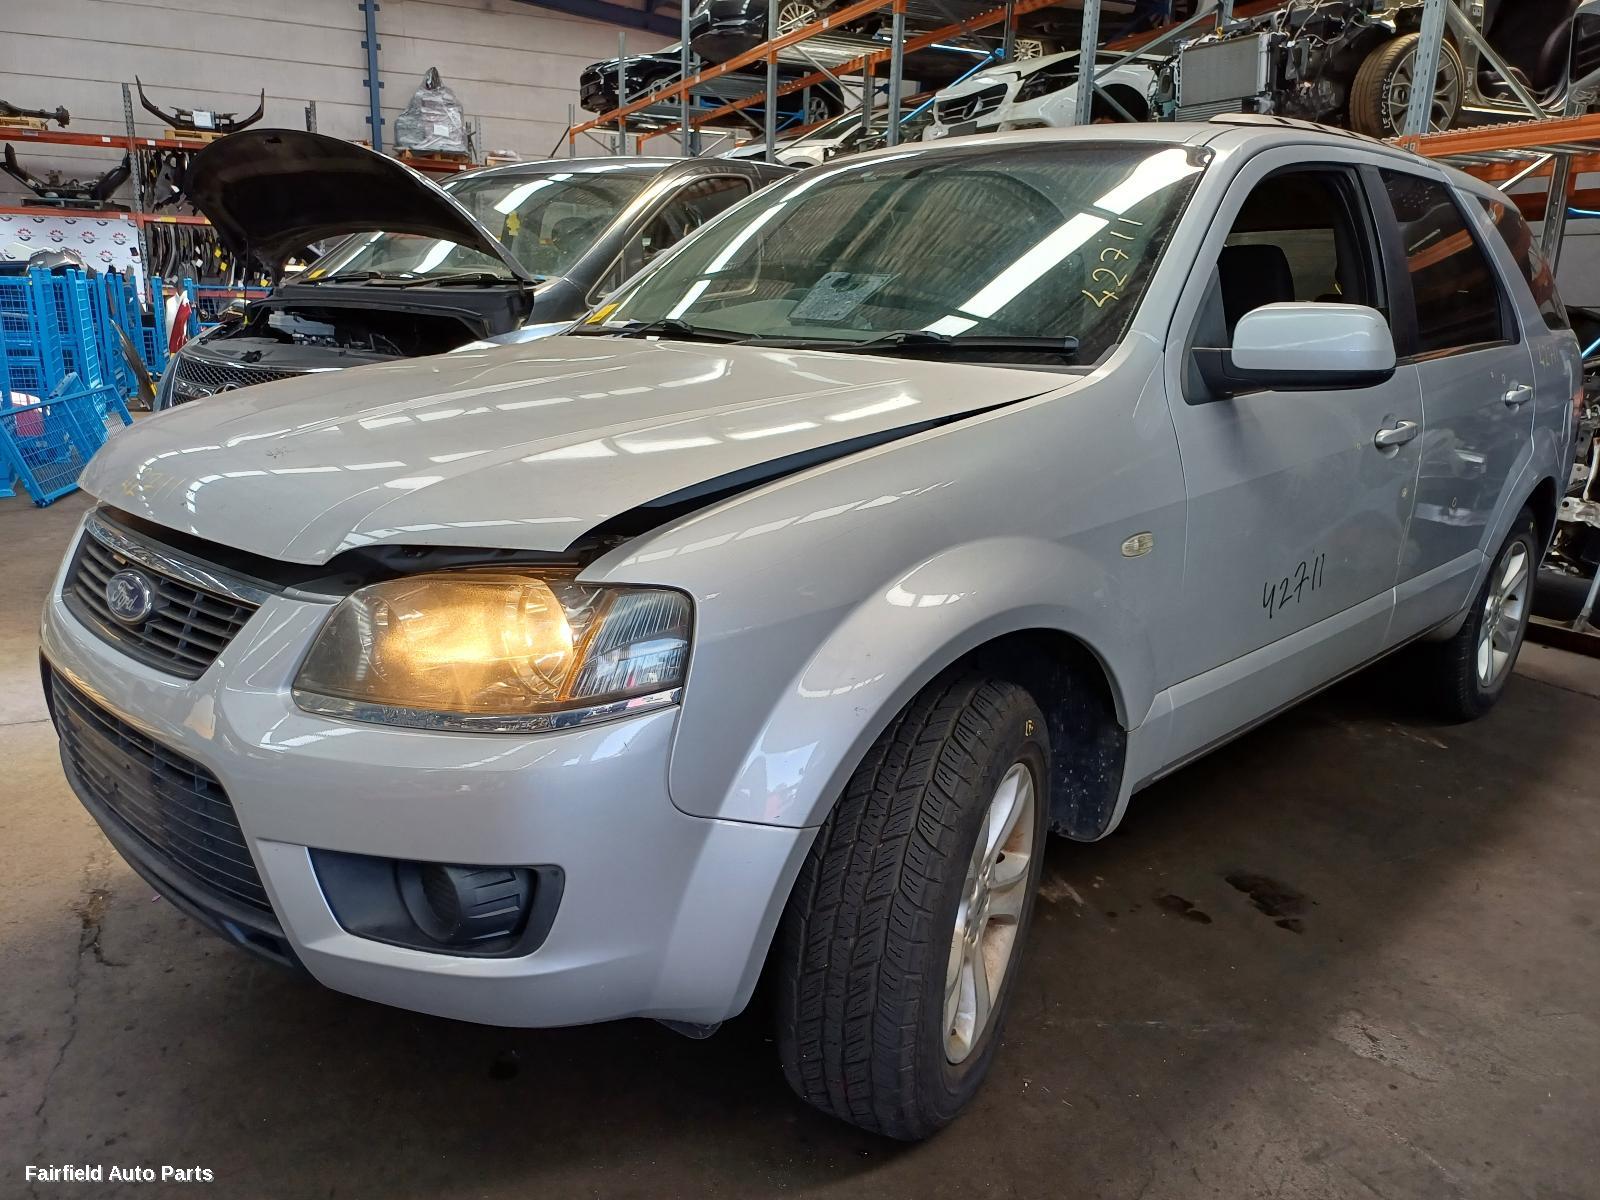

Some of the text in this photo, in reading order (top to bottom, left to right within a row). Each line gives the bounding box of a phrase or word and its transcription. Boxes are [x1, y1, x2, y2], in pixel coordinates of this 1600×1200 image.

[1081, 217, 1144, 308] 42711
[110, 579, 139, 611] Ford
[1262, 552, 1325, 620] 42711
